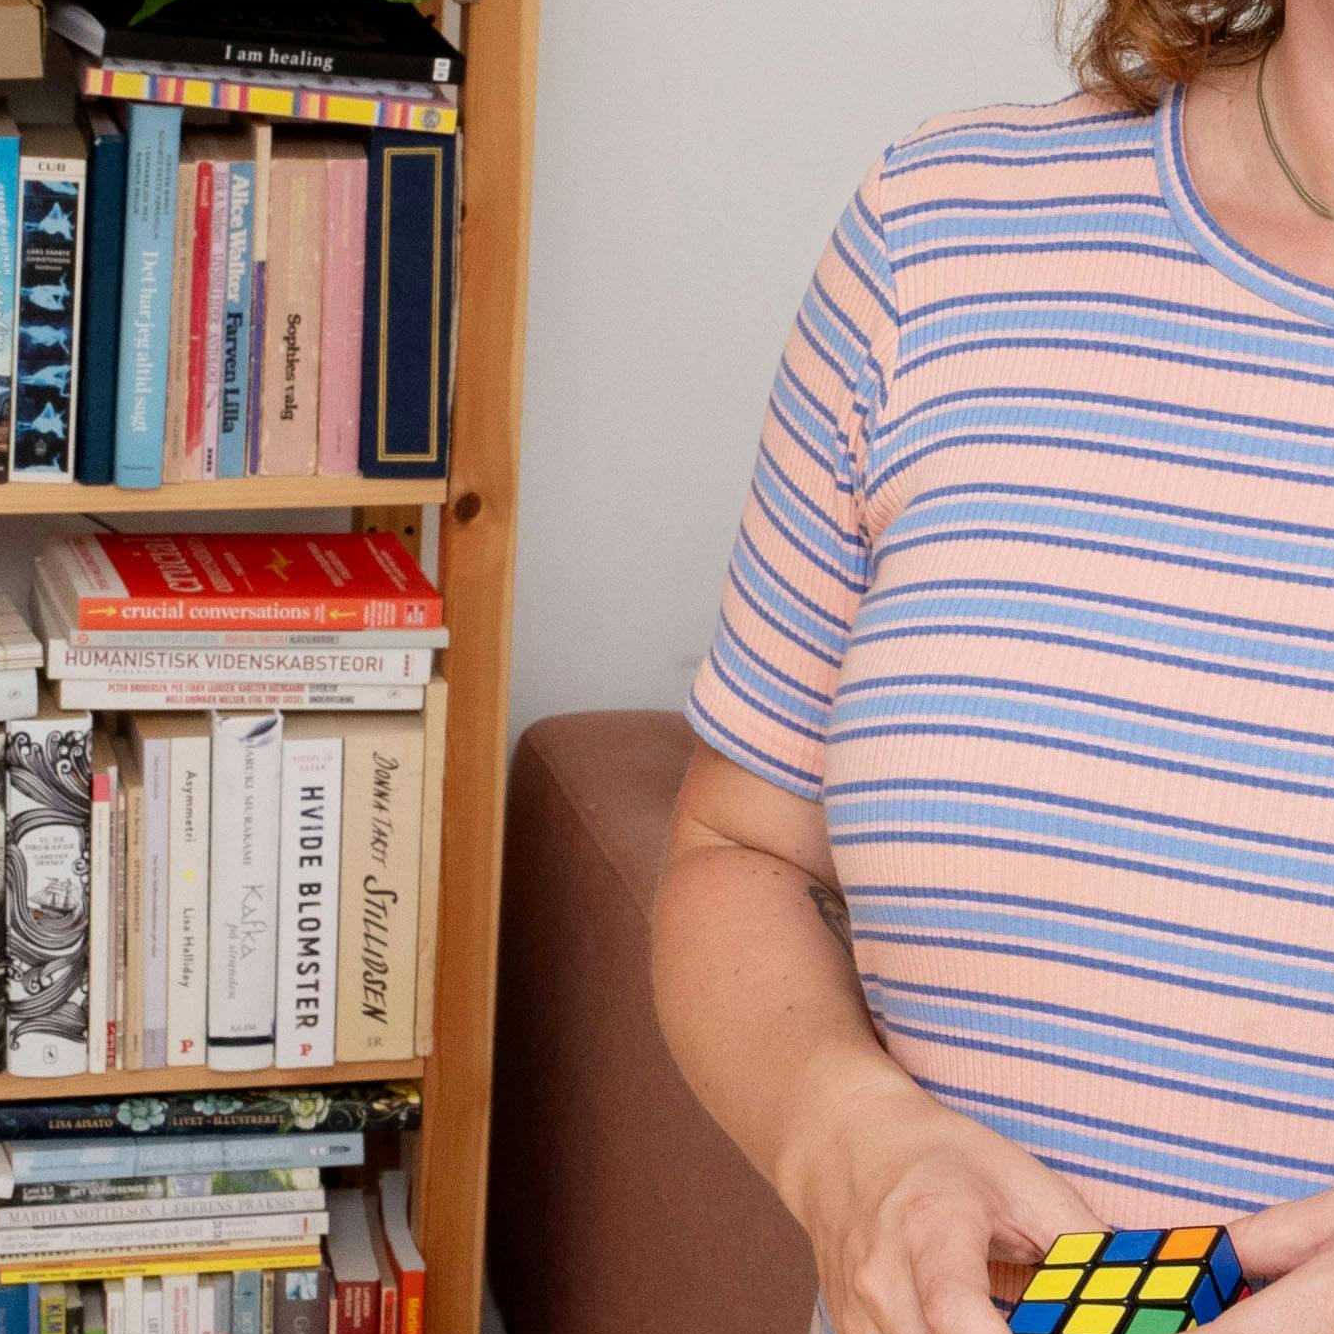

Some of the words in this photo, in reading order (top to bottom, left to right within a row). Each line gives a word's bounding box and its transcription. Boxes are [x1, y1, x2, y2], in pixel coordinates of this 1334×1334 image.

[237, 49, 263, 62] am
[269, 47, 333, 71] healing
[230, 173, 250, 227] Alice
[140, 251, 160, 280] Det
[227, 228, 248, 303] Walker
[137, 287, 158, 317] har
[134, 320, 157, 347] jeg
[224, 312, 243, 382] Farven
[283, 314, 301, 380] Sophies
[135, 352, 154, 389] altid
[132, 395, 148, 432] sagt
[222, 388, 241, 433] Lilla
[281, 386, 298, 420] valg
[122, 602, 184, 619] crucial
[189, 602, 310, 621] conversations
[65, 652, 199, 669] HUMANISTISK
[205, 653, 383, 672] VIDENSKABSTEORI
[372, 751, 400, 813] DONNA
[181, 771, 197, 843] Asymmetri
[299, 786, 324, 868] HVIDE
[182, 908, 195, 931] Lisa
[240, 884, 267, 959] Kafka
[179, 936, 196, 988] Halliday
[295, 883, 323, 1029] BLOMSTER
[361, 875, 398, 1025] STILLIDSEN
[45, 1304, 63, 1333] KLM
